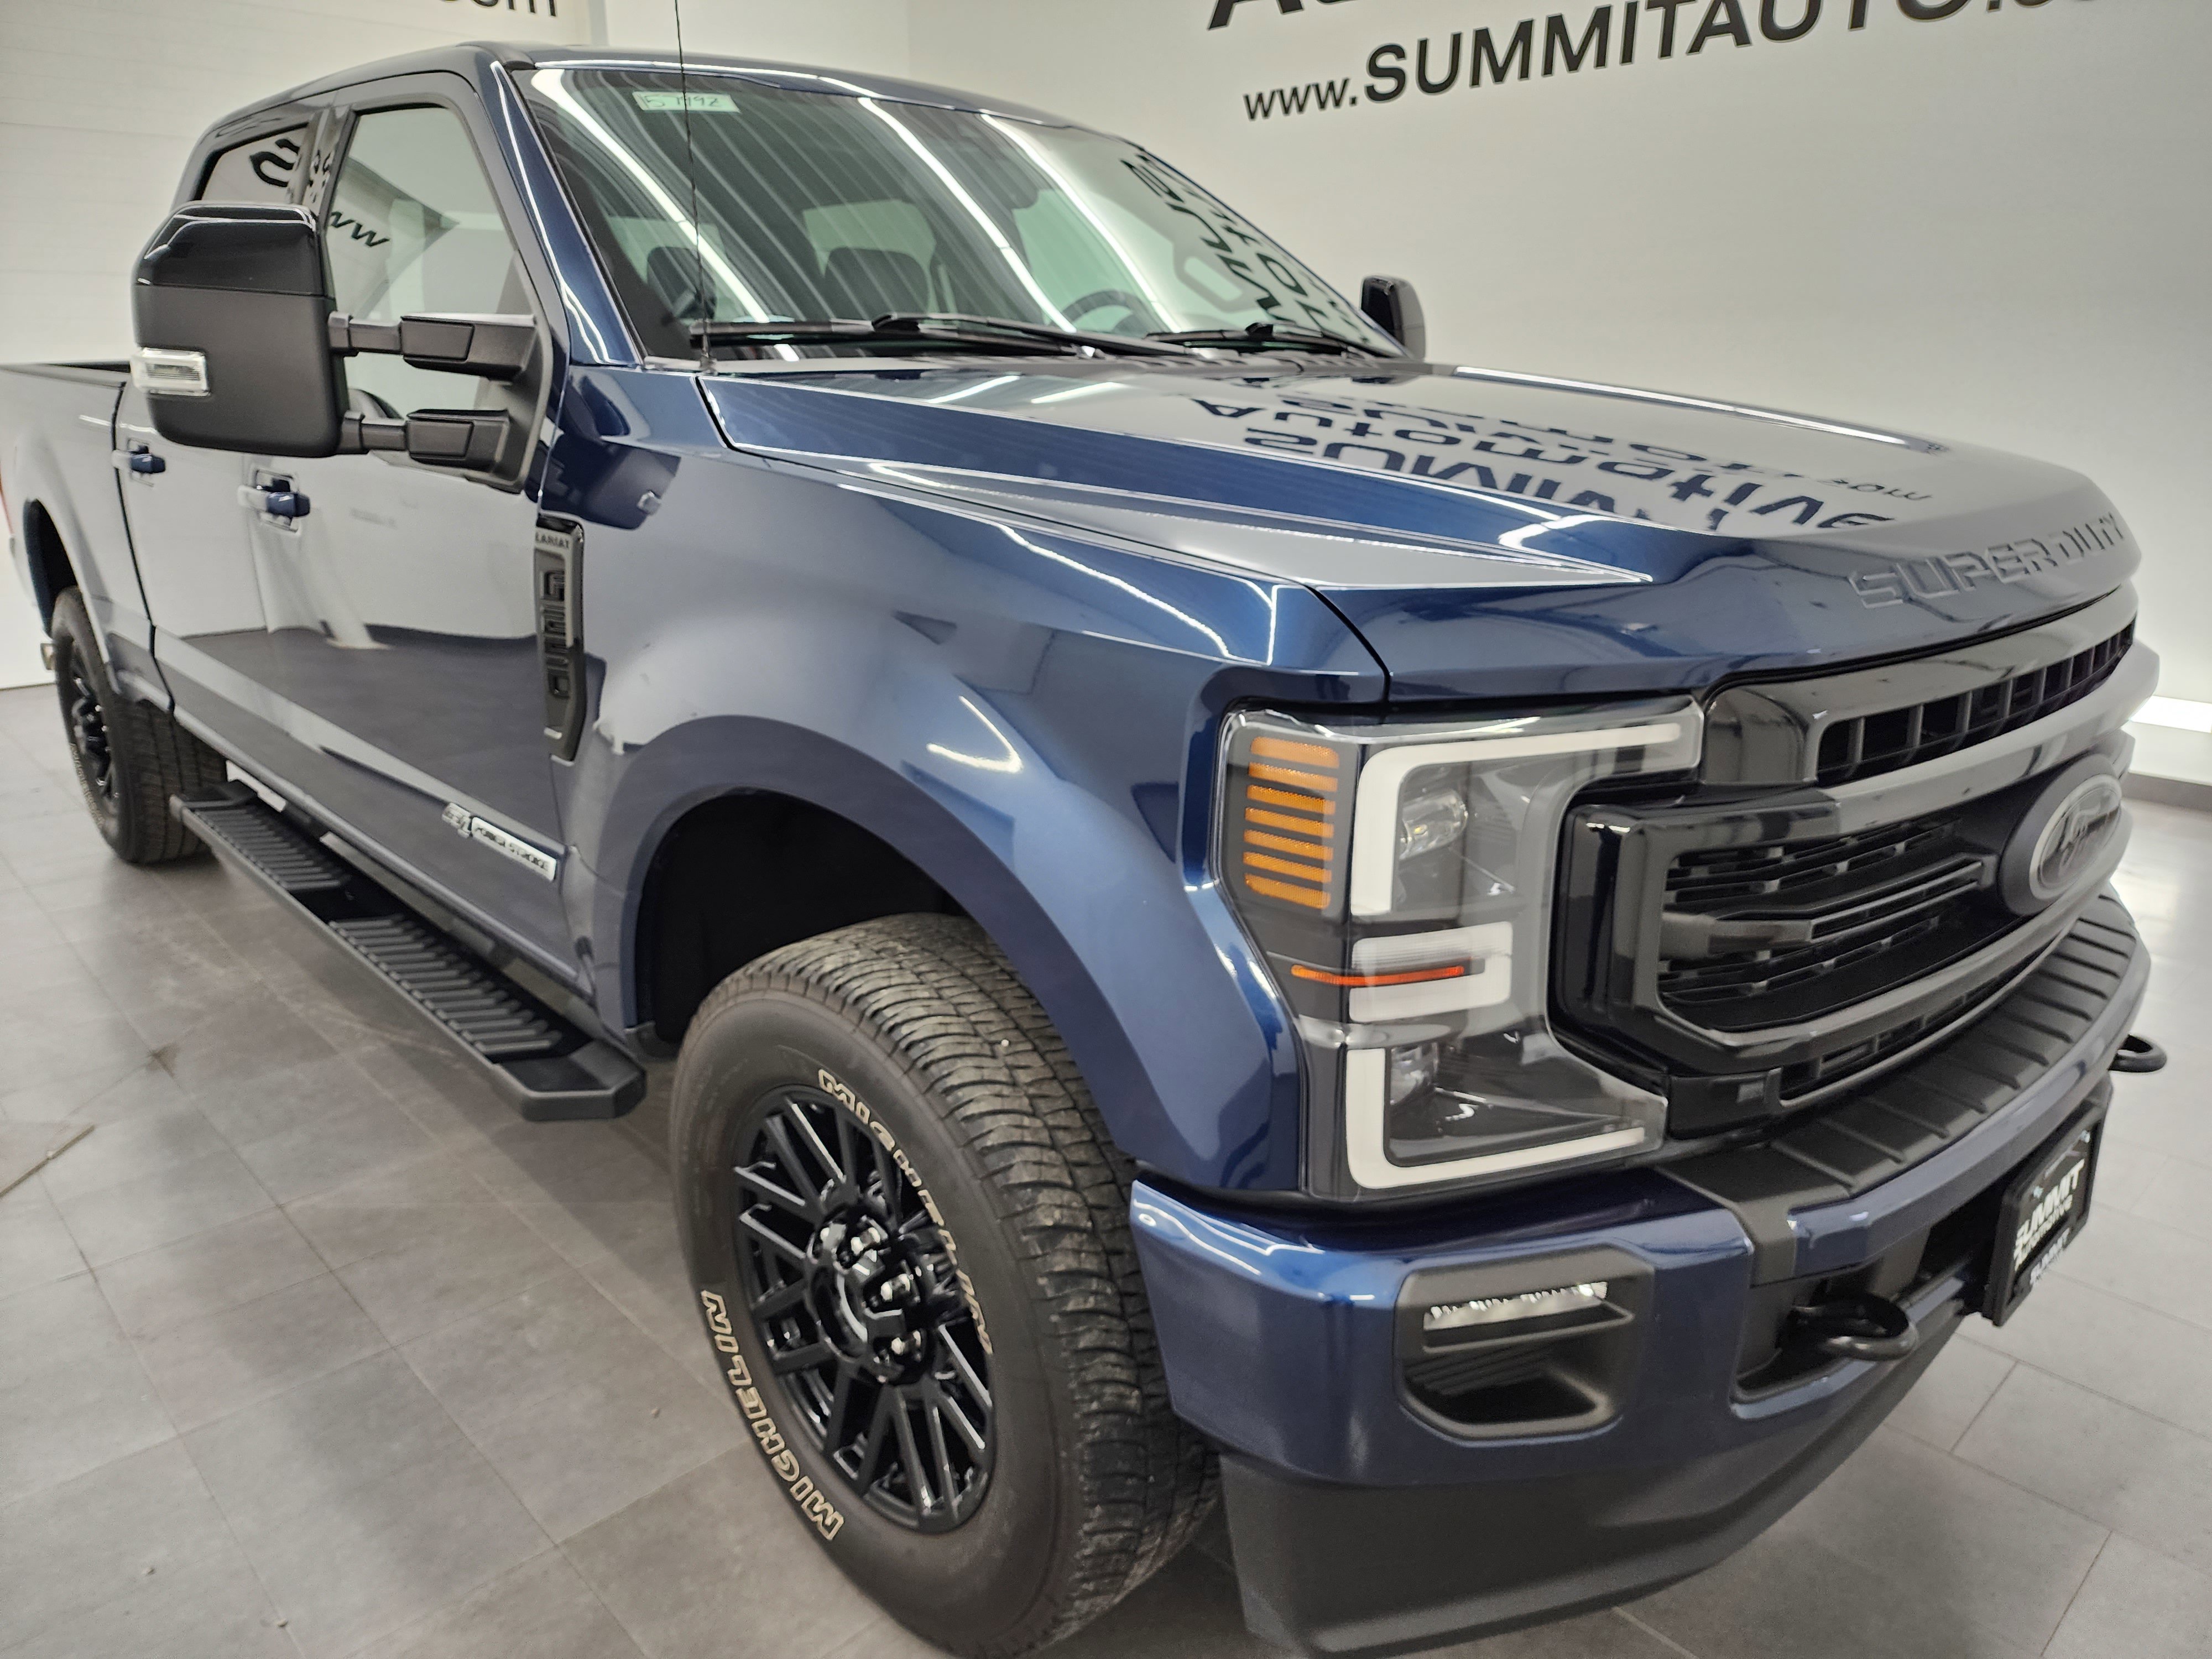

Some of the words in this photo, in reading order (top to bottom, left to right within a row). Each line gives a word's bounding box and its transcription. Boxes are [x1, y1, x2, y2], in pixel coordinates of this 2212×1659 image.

[1848, 536, 2058, 608] SUPER
[818, 1068, 993, 1354] MICHELIN
[701, 1290, 844, 1541] MICHELIN
